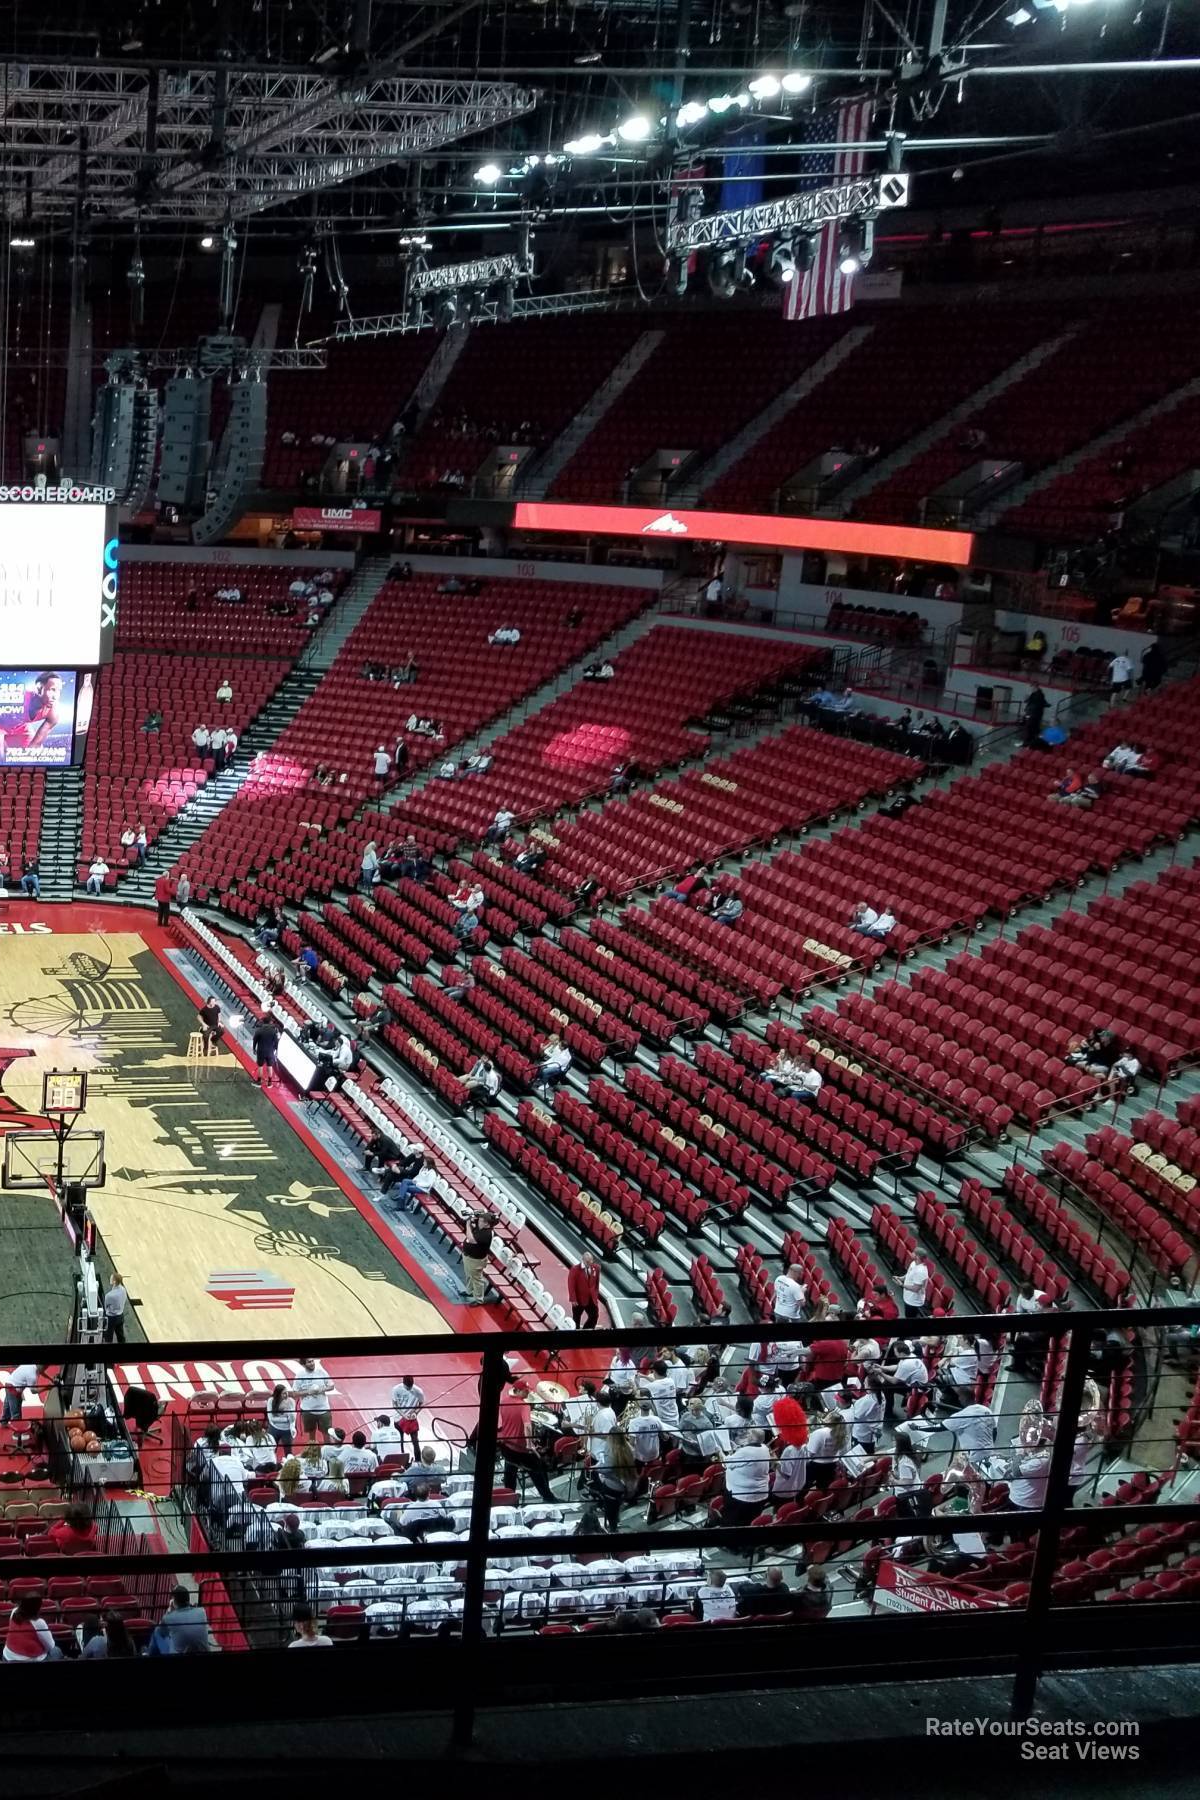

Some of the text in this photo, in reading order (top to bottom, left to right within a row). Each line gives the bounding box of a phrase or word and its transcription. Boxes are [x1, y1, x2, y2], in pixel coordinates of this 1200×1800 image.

[0, 486, 116, 502] SCOREBOARD
[321, 508, 353, 519] UMC
[516, 564, 535, 576] 103
[101, 538, 119, 628] COX
[1060, 625, 1080, 643] 105
[895, 1588, 929, 1609] Student
